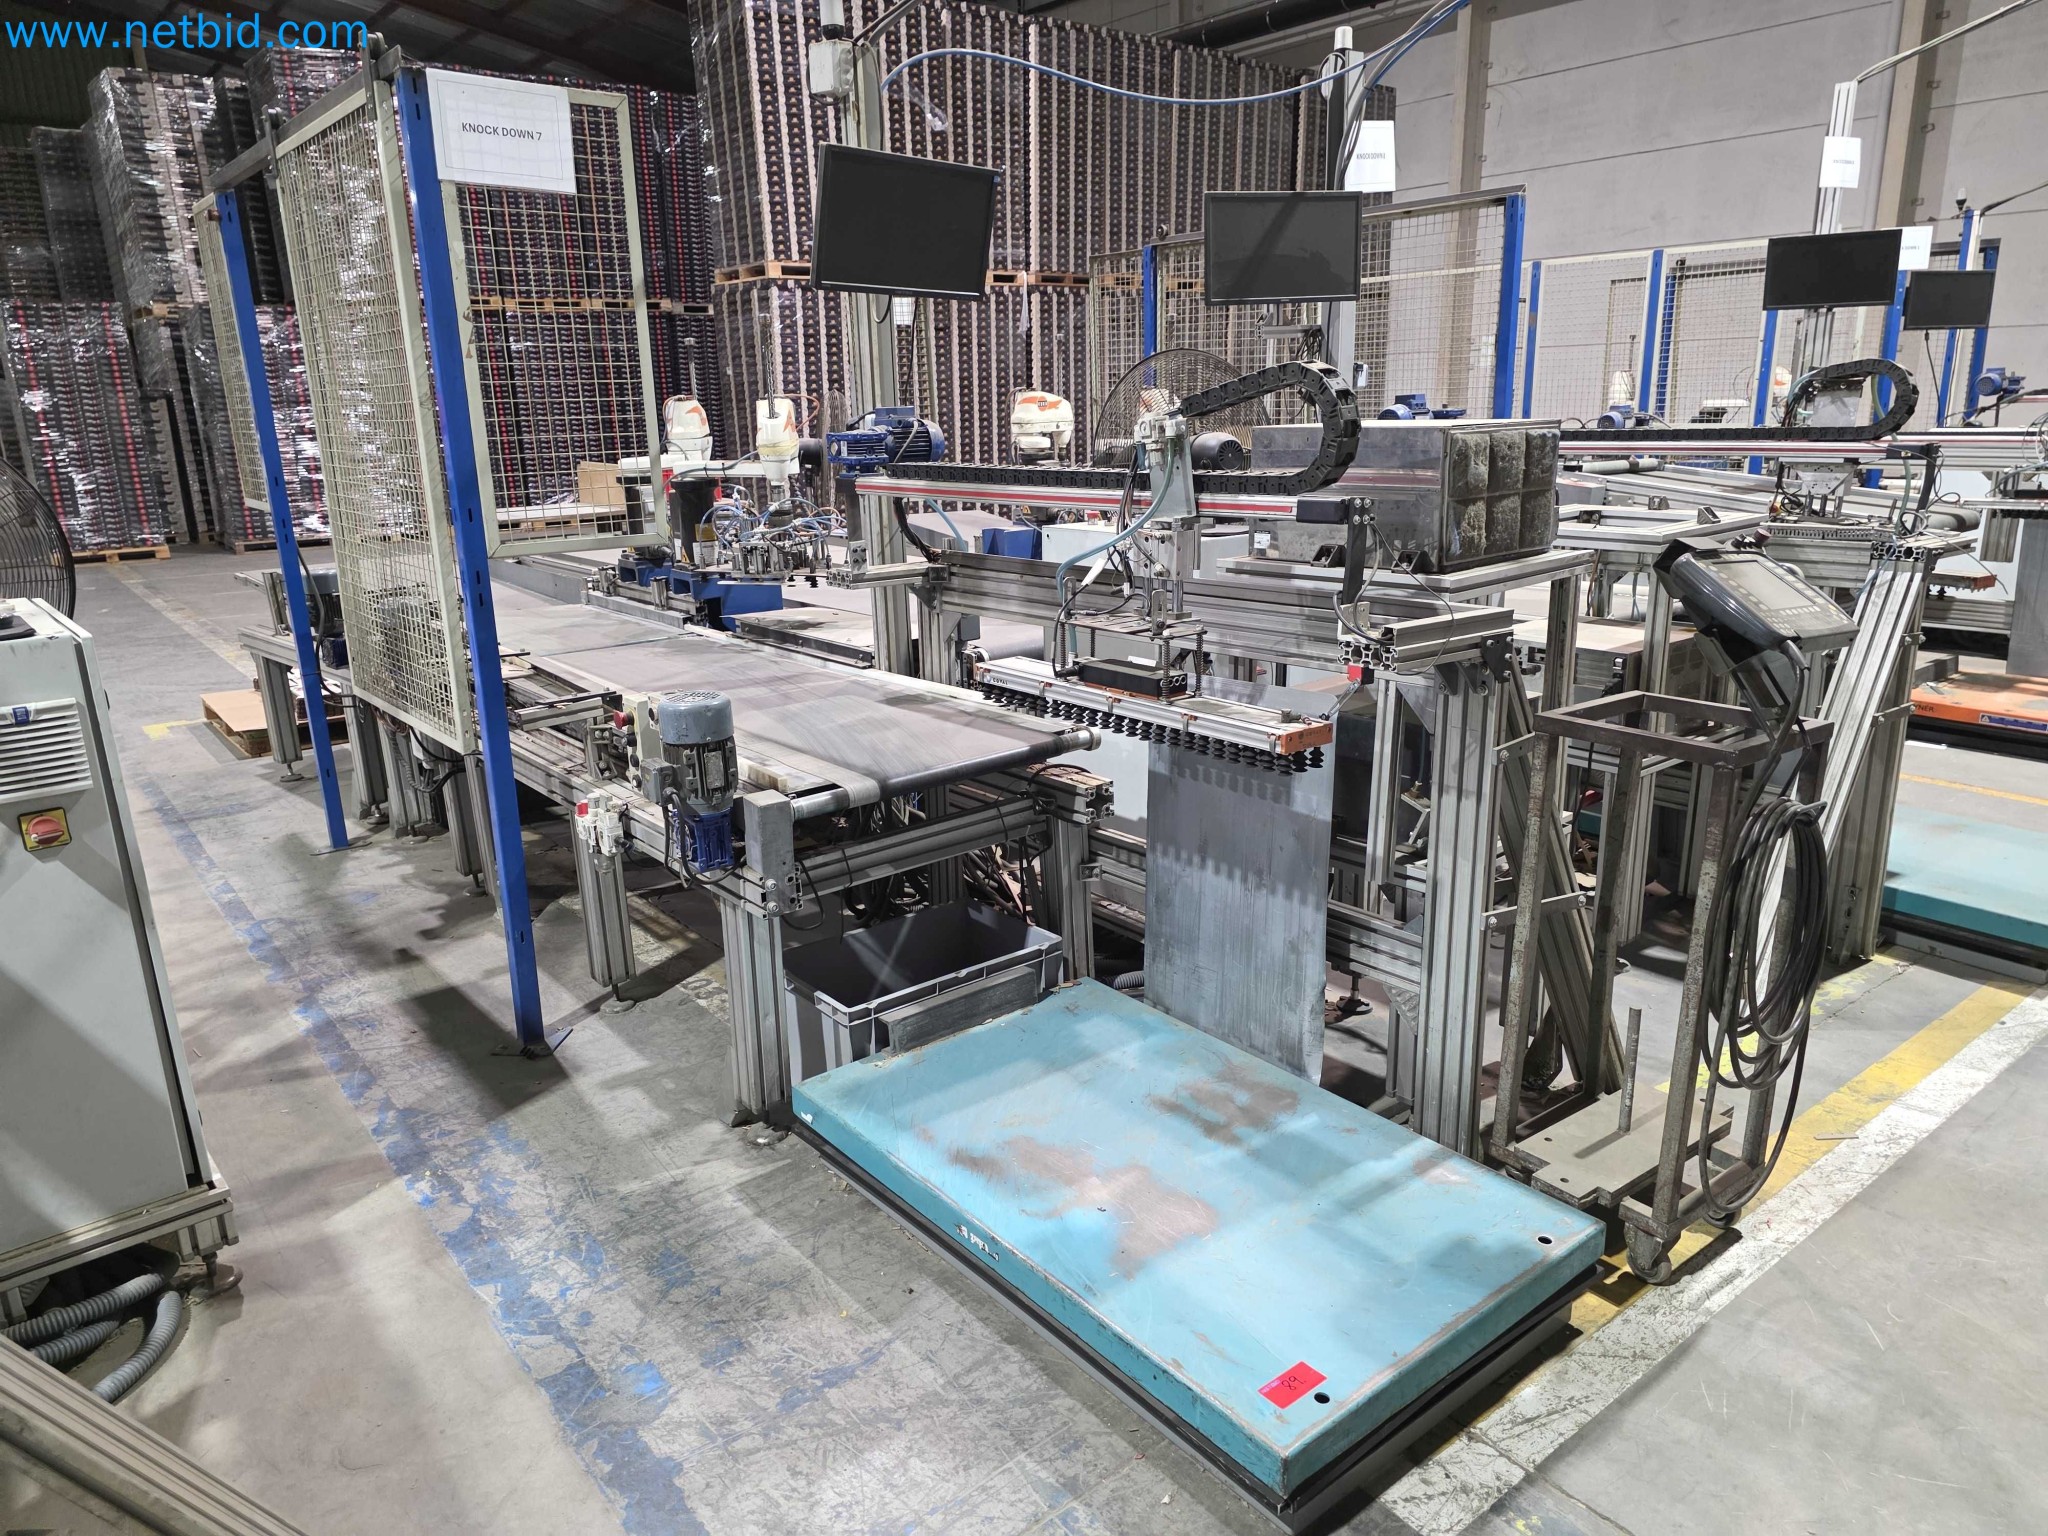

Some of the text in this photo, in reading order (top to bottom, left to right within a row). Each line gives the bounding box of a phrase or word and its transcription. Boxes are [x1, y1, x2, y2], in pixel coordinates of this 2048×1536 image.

[461, 122, 542, 141] KNOCK DOWN 7
